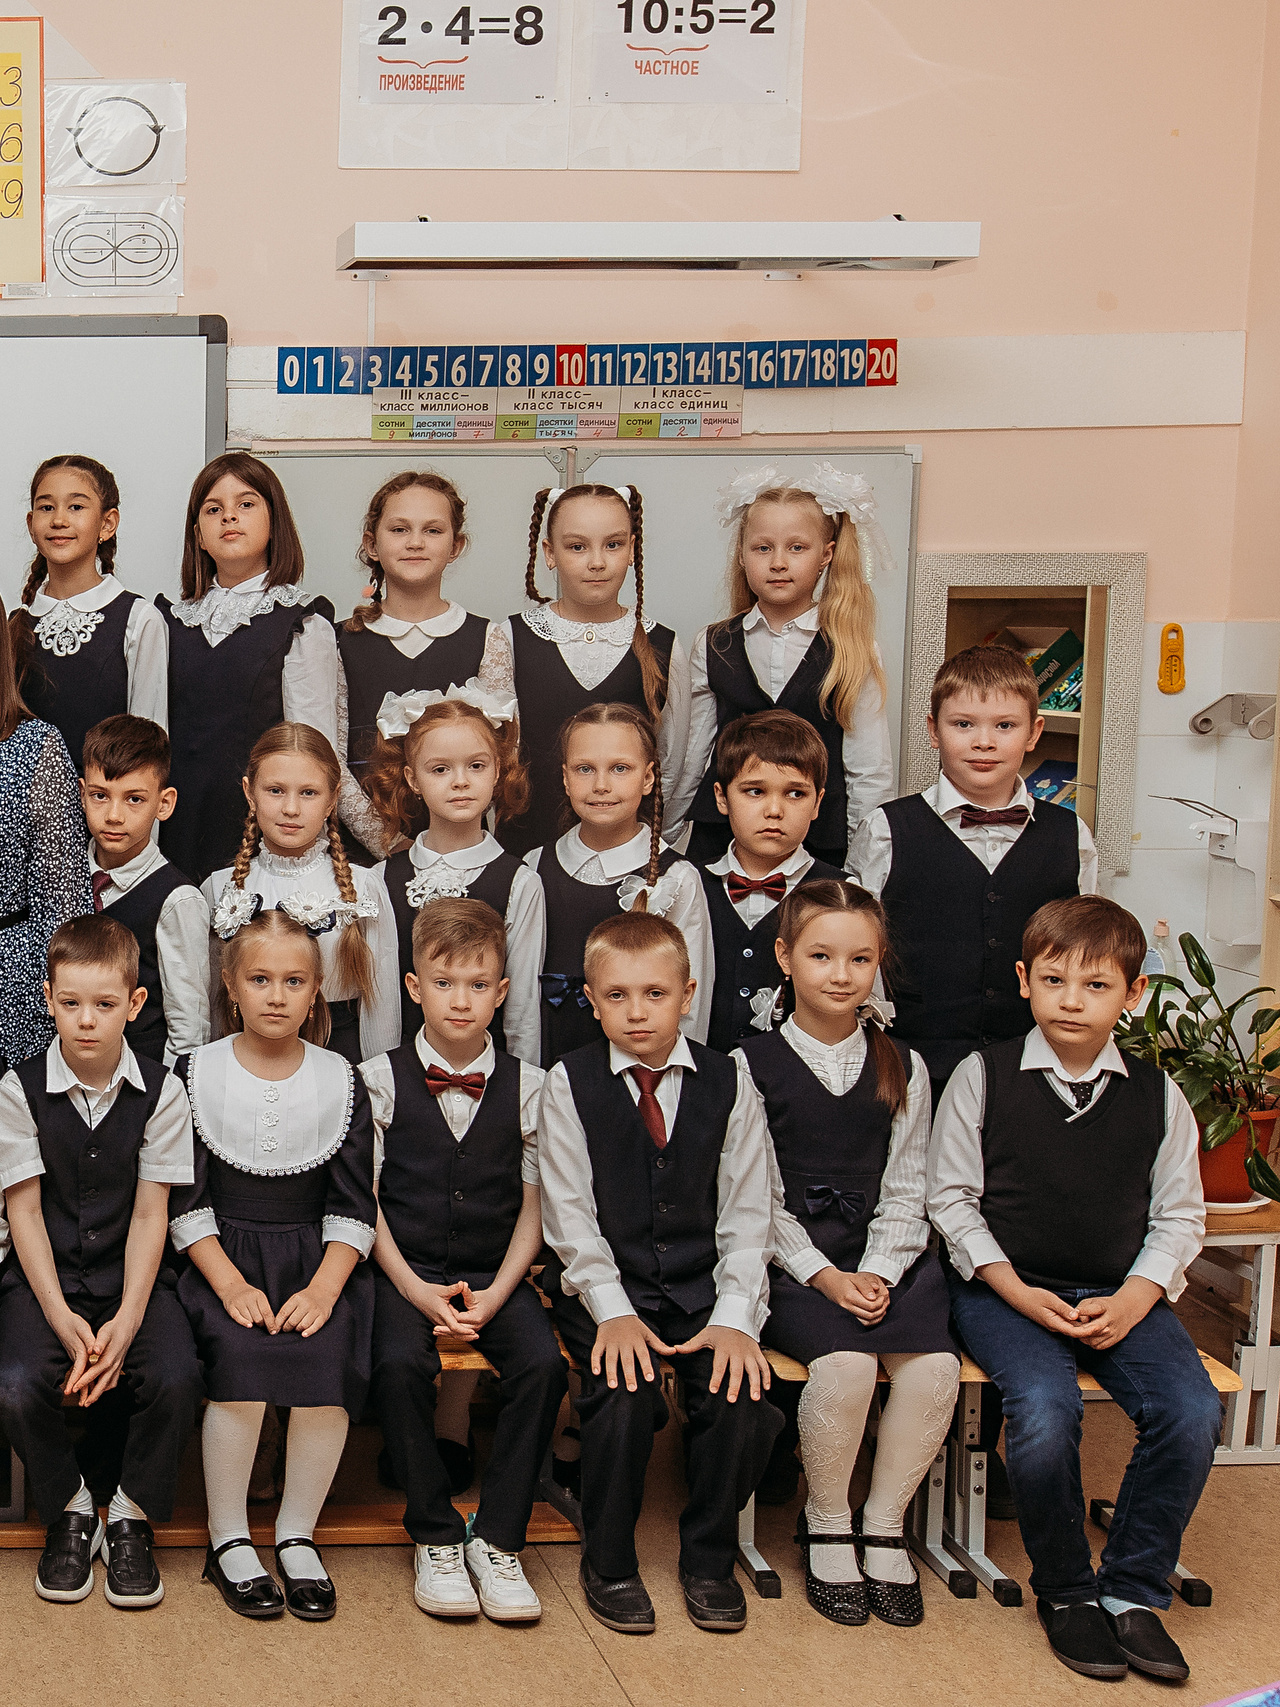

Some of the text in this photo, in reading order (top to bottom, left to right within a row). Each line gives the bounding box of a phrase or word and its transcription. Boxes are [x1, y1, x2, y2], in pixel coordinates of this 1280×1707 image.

[618, 0, 776, 34] 10:5=2
[634, 60, 699, 76] ЧАСТНОЕ
[0, 66, 22, 107] 3
[379, 74, 465, 94] ПРОИЗВЕДЕНИЕ
[0, 123, 23, 162] 6
[0, 179, 23, 218] 9
[283, 347, 894, 387] 0 1 2 3 4 5 6 7 8 9 10 11 12 13 14 15 16 17 18 19 20
[380, 402, 489, 411] класс миллионов
[514, 401, 602, 410] класс тысяч
[634, 400, 728, 410] класс единиц
[379, 420, 405, 428] сотни
[416, 420, 451, 428] десятки
[503, 419, 529, 427] сотни
[539, 419, 573, 427] десятки
[626, 417, 739, 426] сотни десятки единицы
